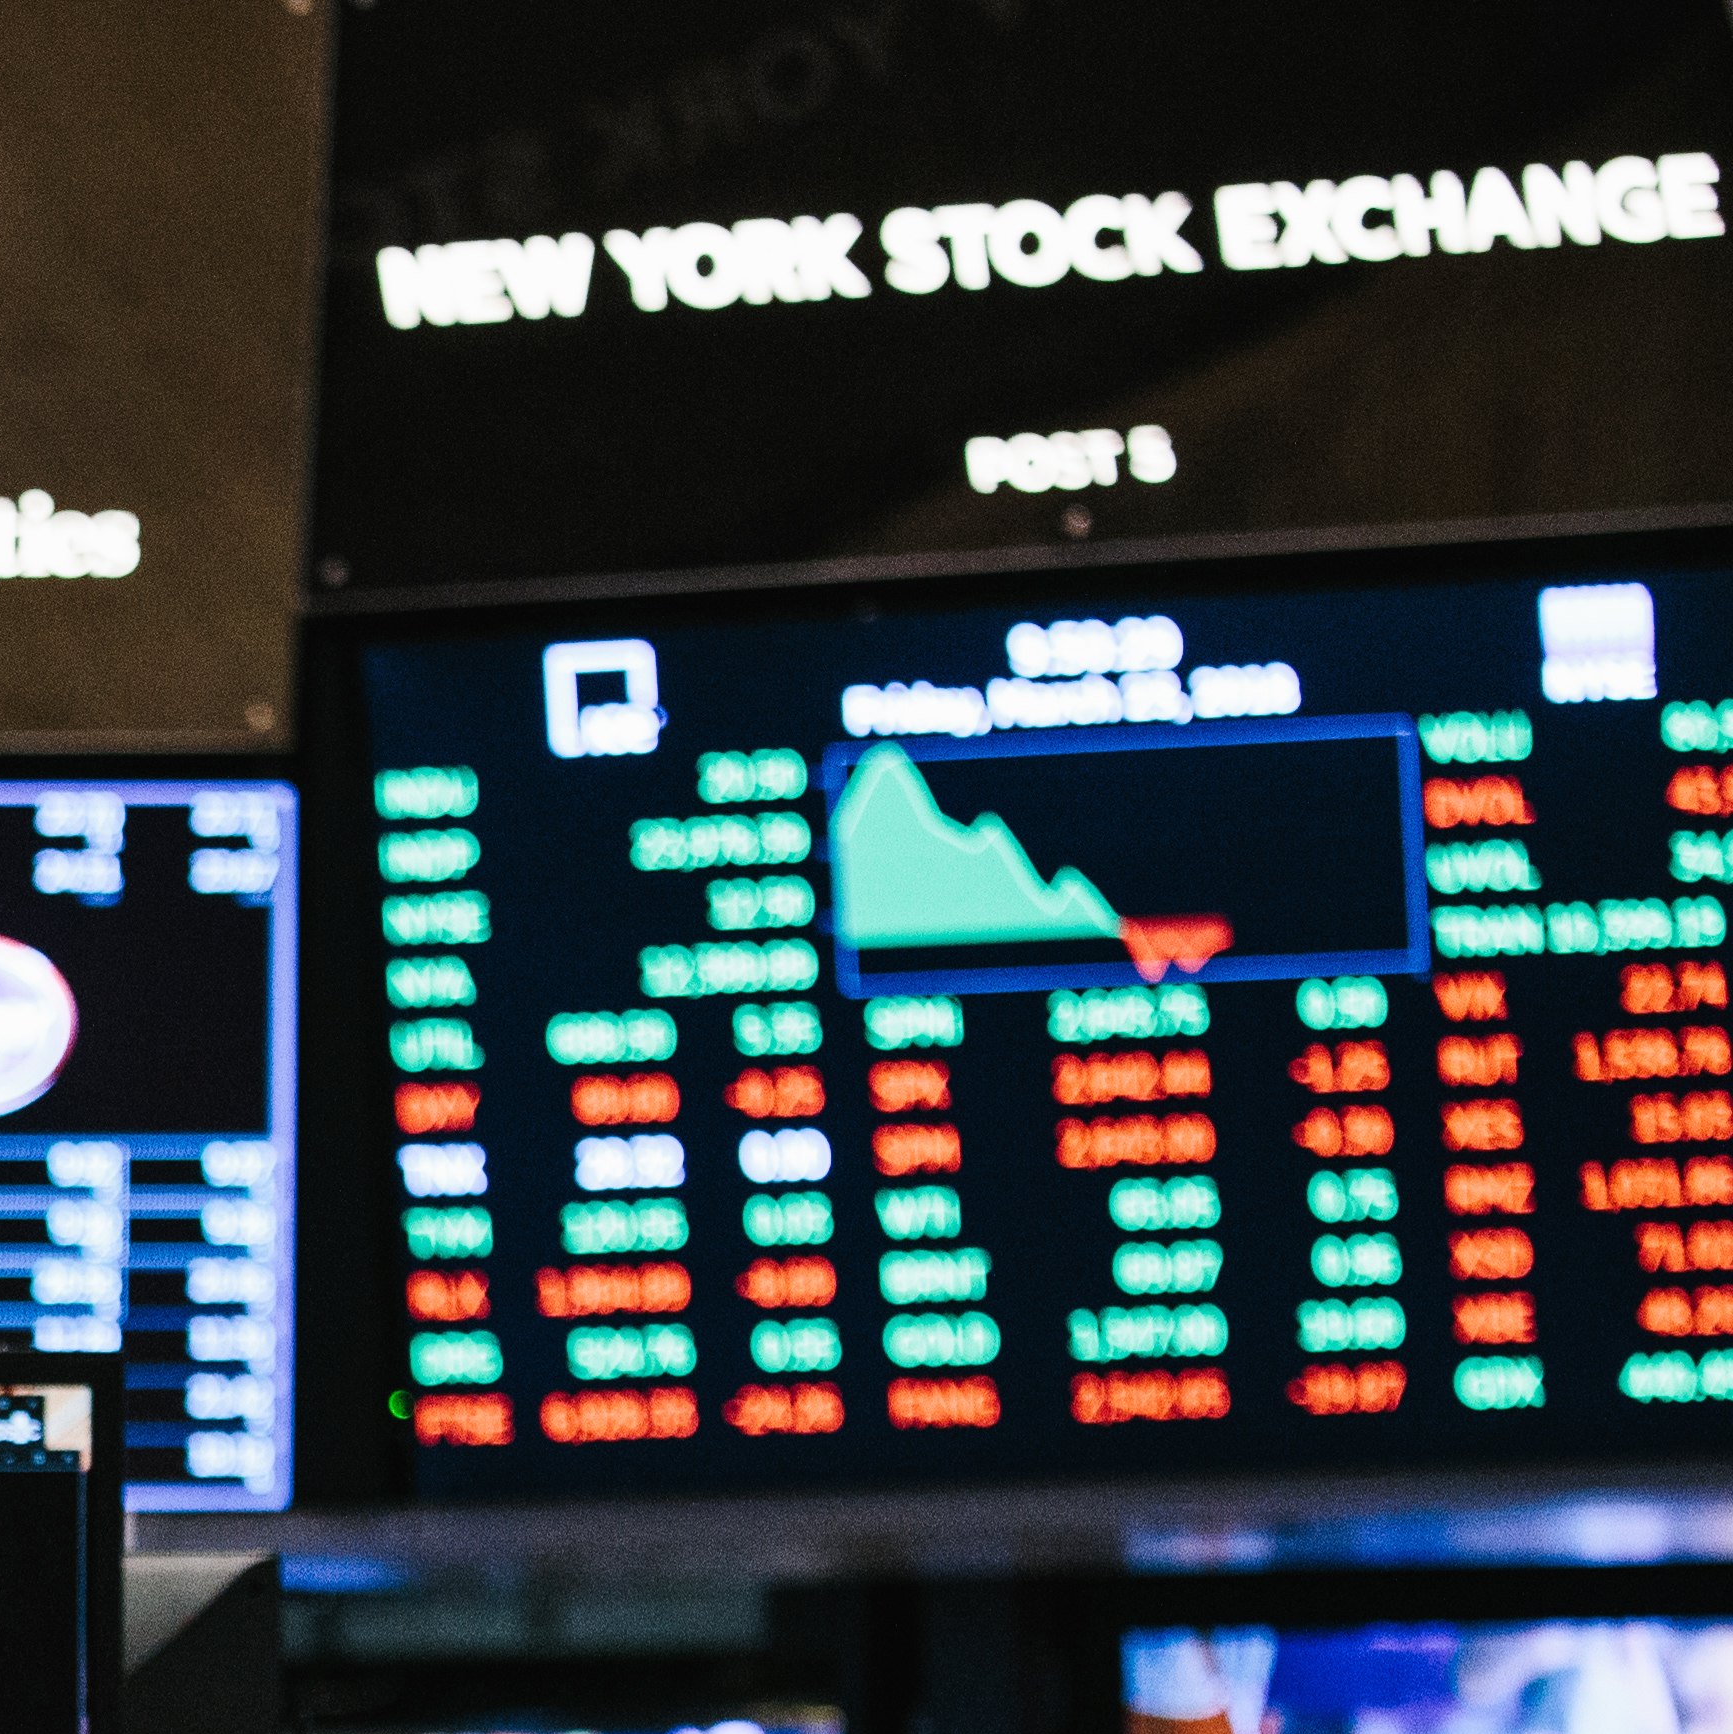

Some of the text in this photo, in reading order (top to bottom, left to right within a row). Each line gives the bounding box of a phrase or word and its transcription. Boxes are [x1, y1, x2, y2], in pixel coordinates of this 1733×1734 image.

[376, 152, 1724, 329] NEW YORK STOCK EXCHANGE
[965, 429, 1121, 493] POST
